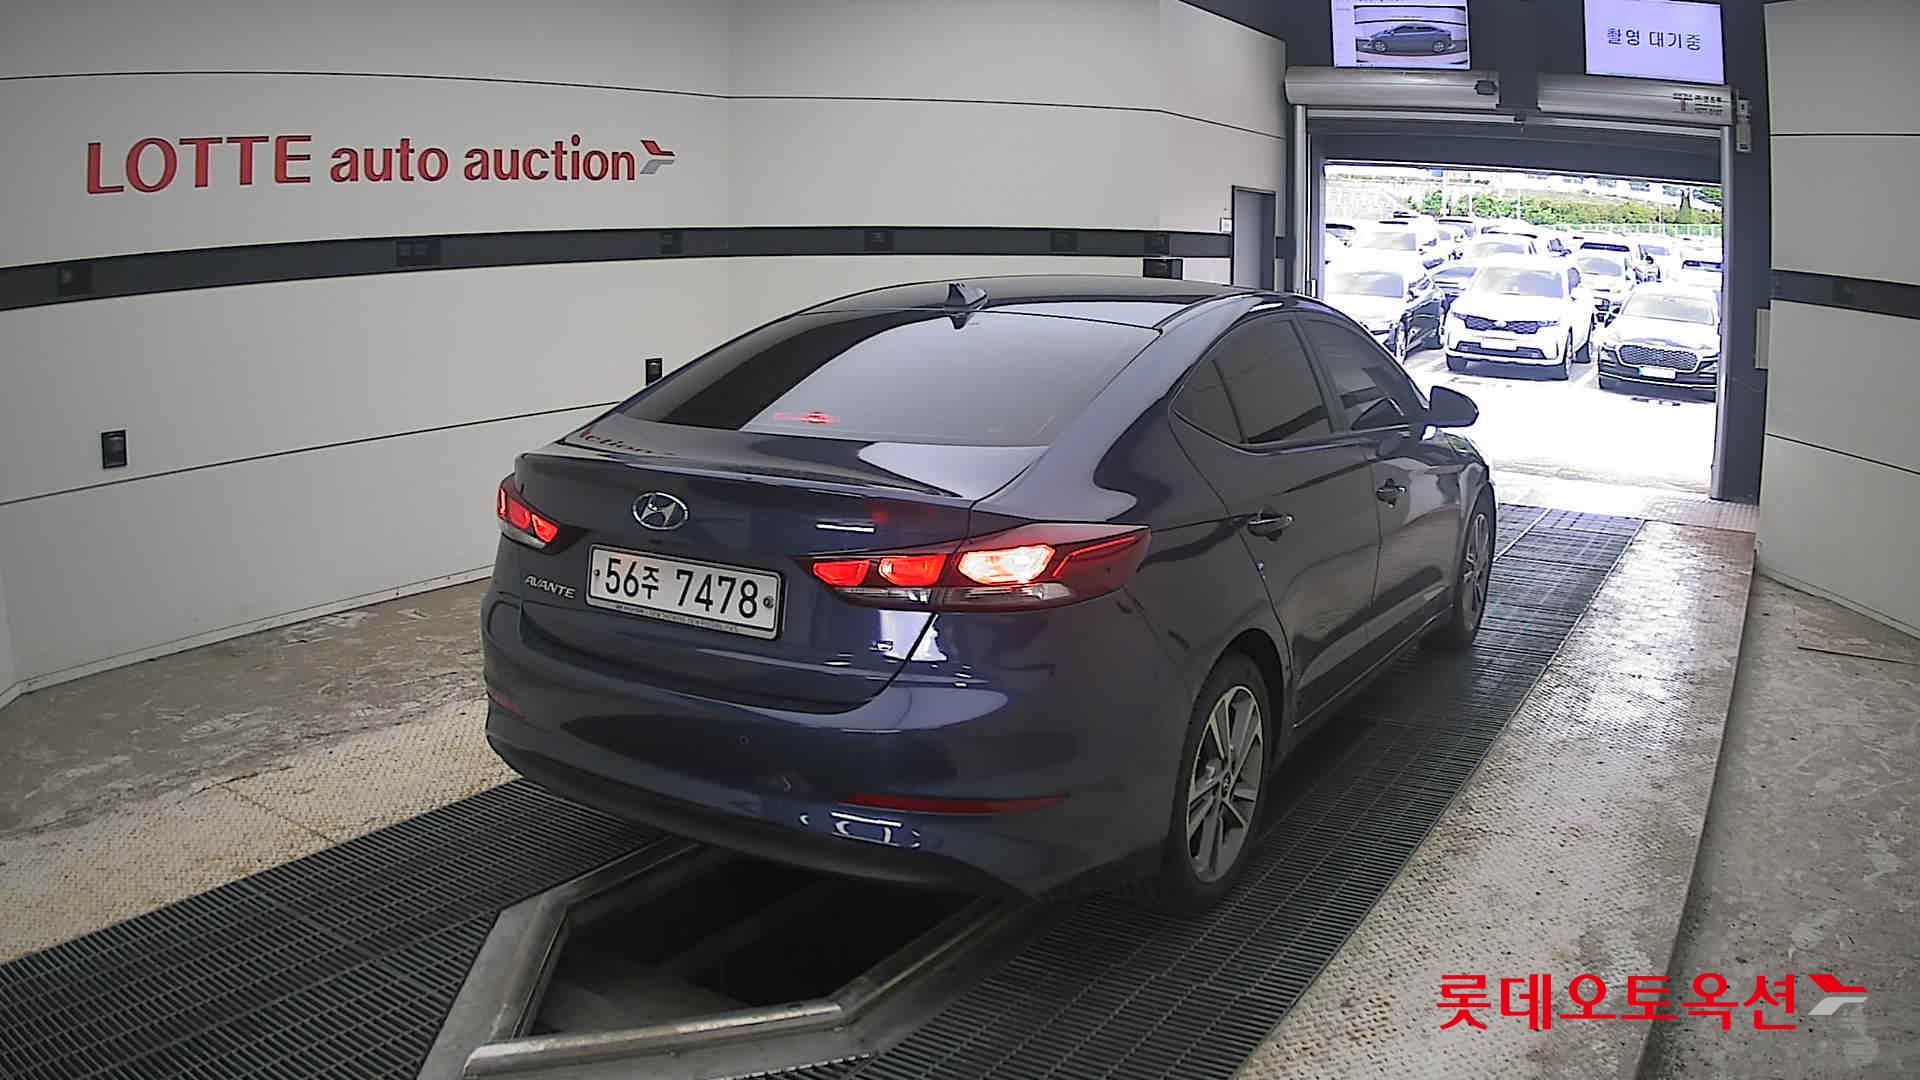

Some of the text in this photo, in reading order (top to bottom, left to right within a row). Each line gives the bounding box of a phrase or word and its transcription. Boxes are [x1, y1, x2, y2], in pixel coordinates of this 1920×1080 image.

[1649, 31, 1702, 51] 대기중
[86, 133, 637, 194] LOTTE auto auction
[524, 575, 577, 599] AVANTE
[604, 557, 660, 600] 56주
[675, 568, 758, 619] 7478
